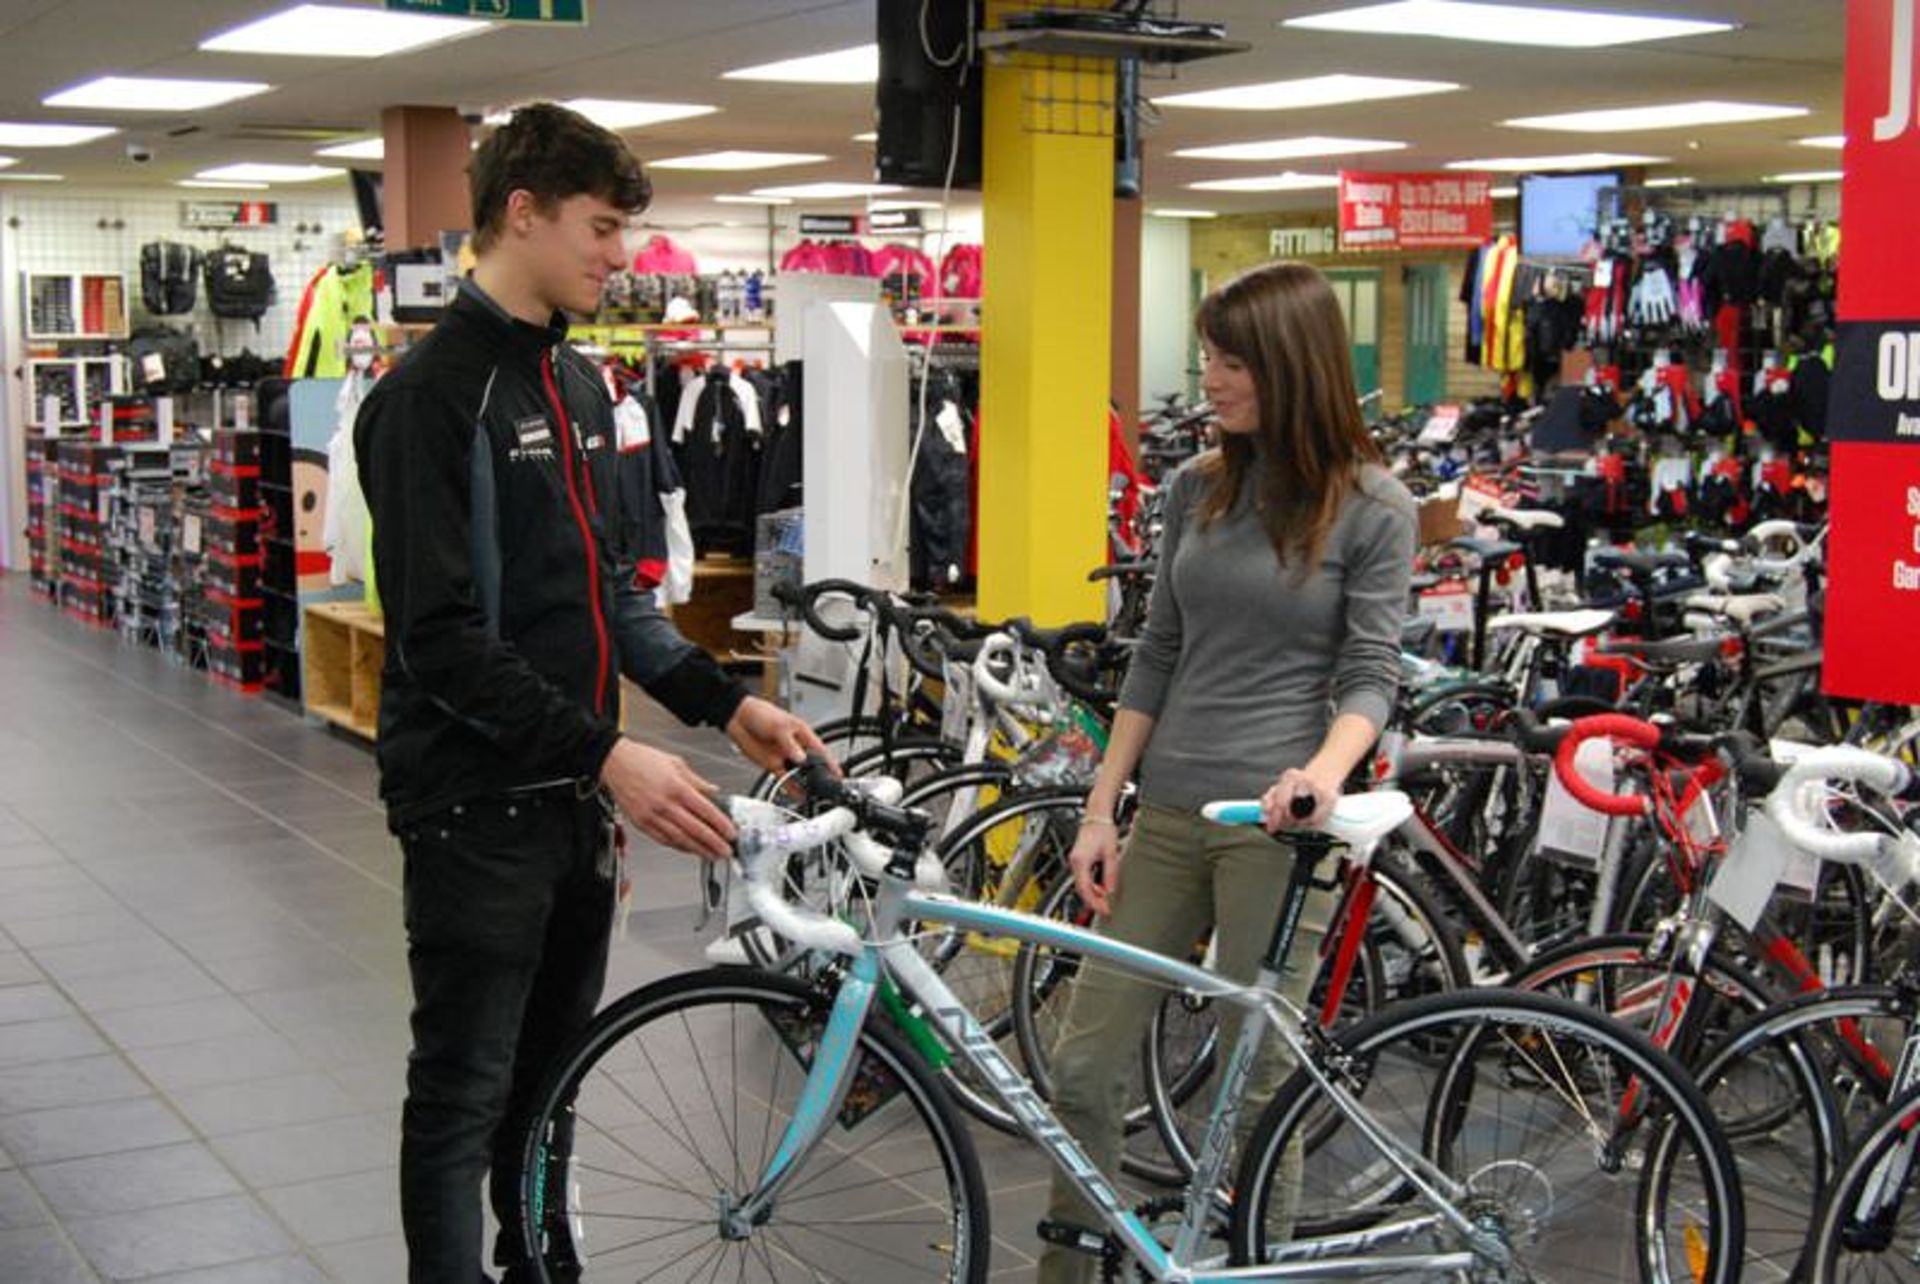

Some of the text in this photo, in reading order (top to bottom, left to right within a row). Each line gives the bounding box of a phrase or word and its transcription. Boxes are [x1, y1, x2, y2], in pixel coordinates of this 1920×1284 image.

[1874, 0, 1920, 141] J
[1270, 228, 1334, 256] FITTING
[936, 1007, 1121, 1213] NORCO
